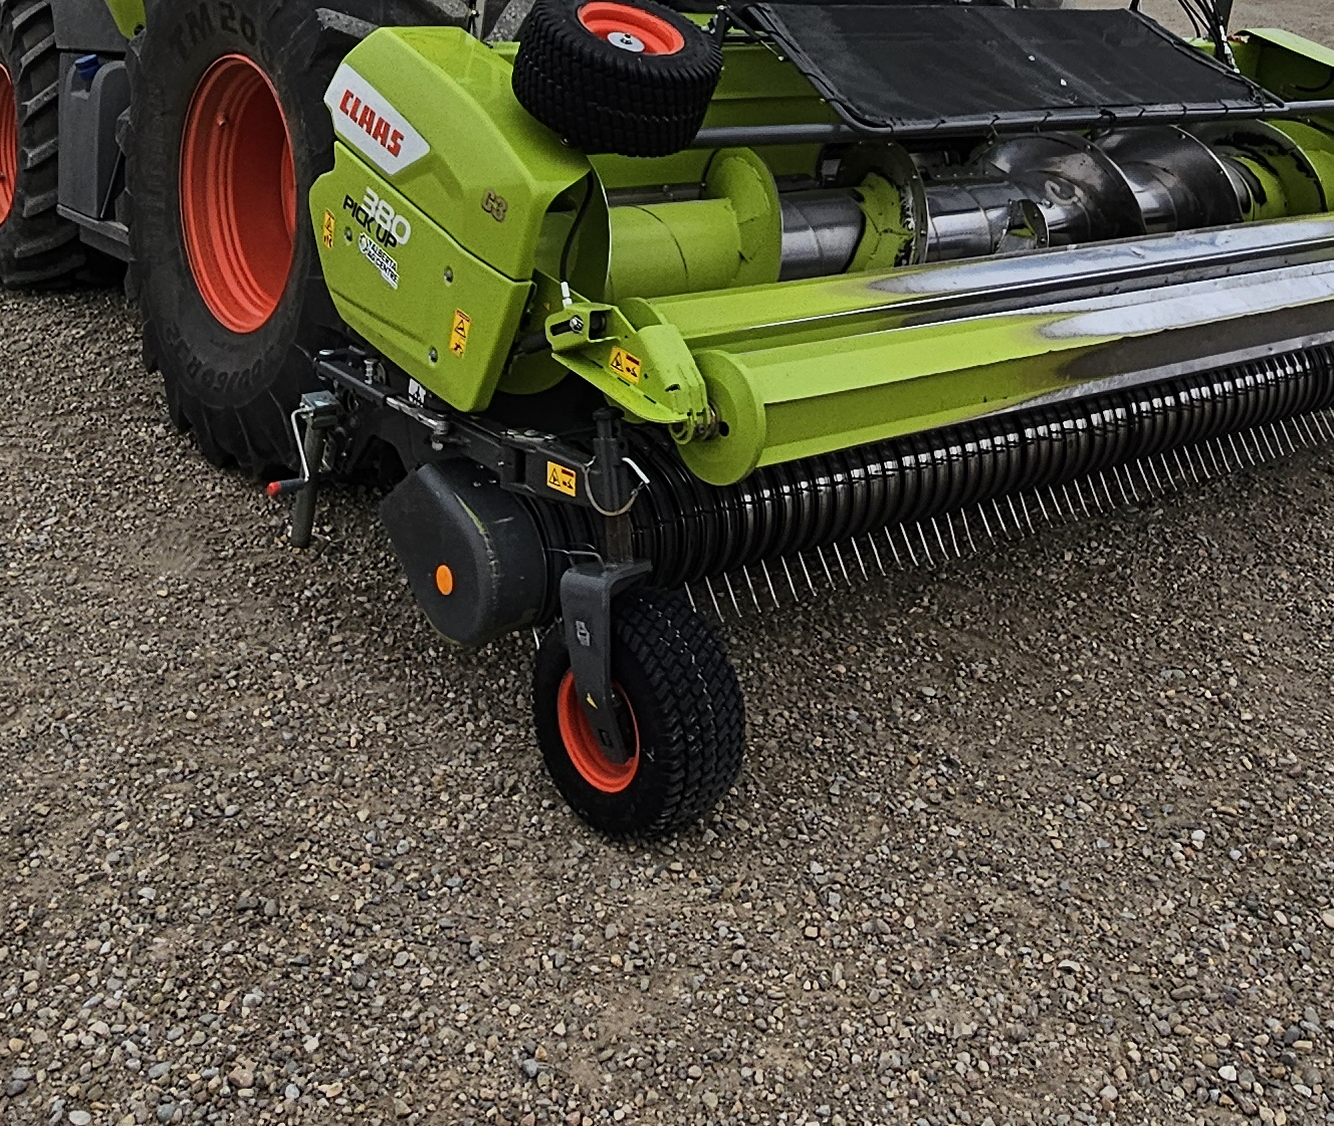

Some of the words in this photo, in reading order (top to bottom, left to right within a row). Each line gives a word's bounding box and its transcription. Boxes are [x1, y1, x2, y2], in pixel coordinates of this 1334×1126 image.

[339, 89, 405, 158] CLAAS
[343, 194, 375, 234] PICK
[376, 222, 398, 248] UP
[361, 186, 411, 245] 380
[482, 188, 508, 222] C3
